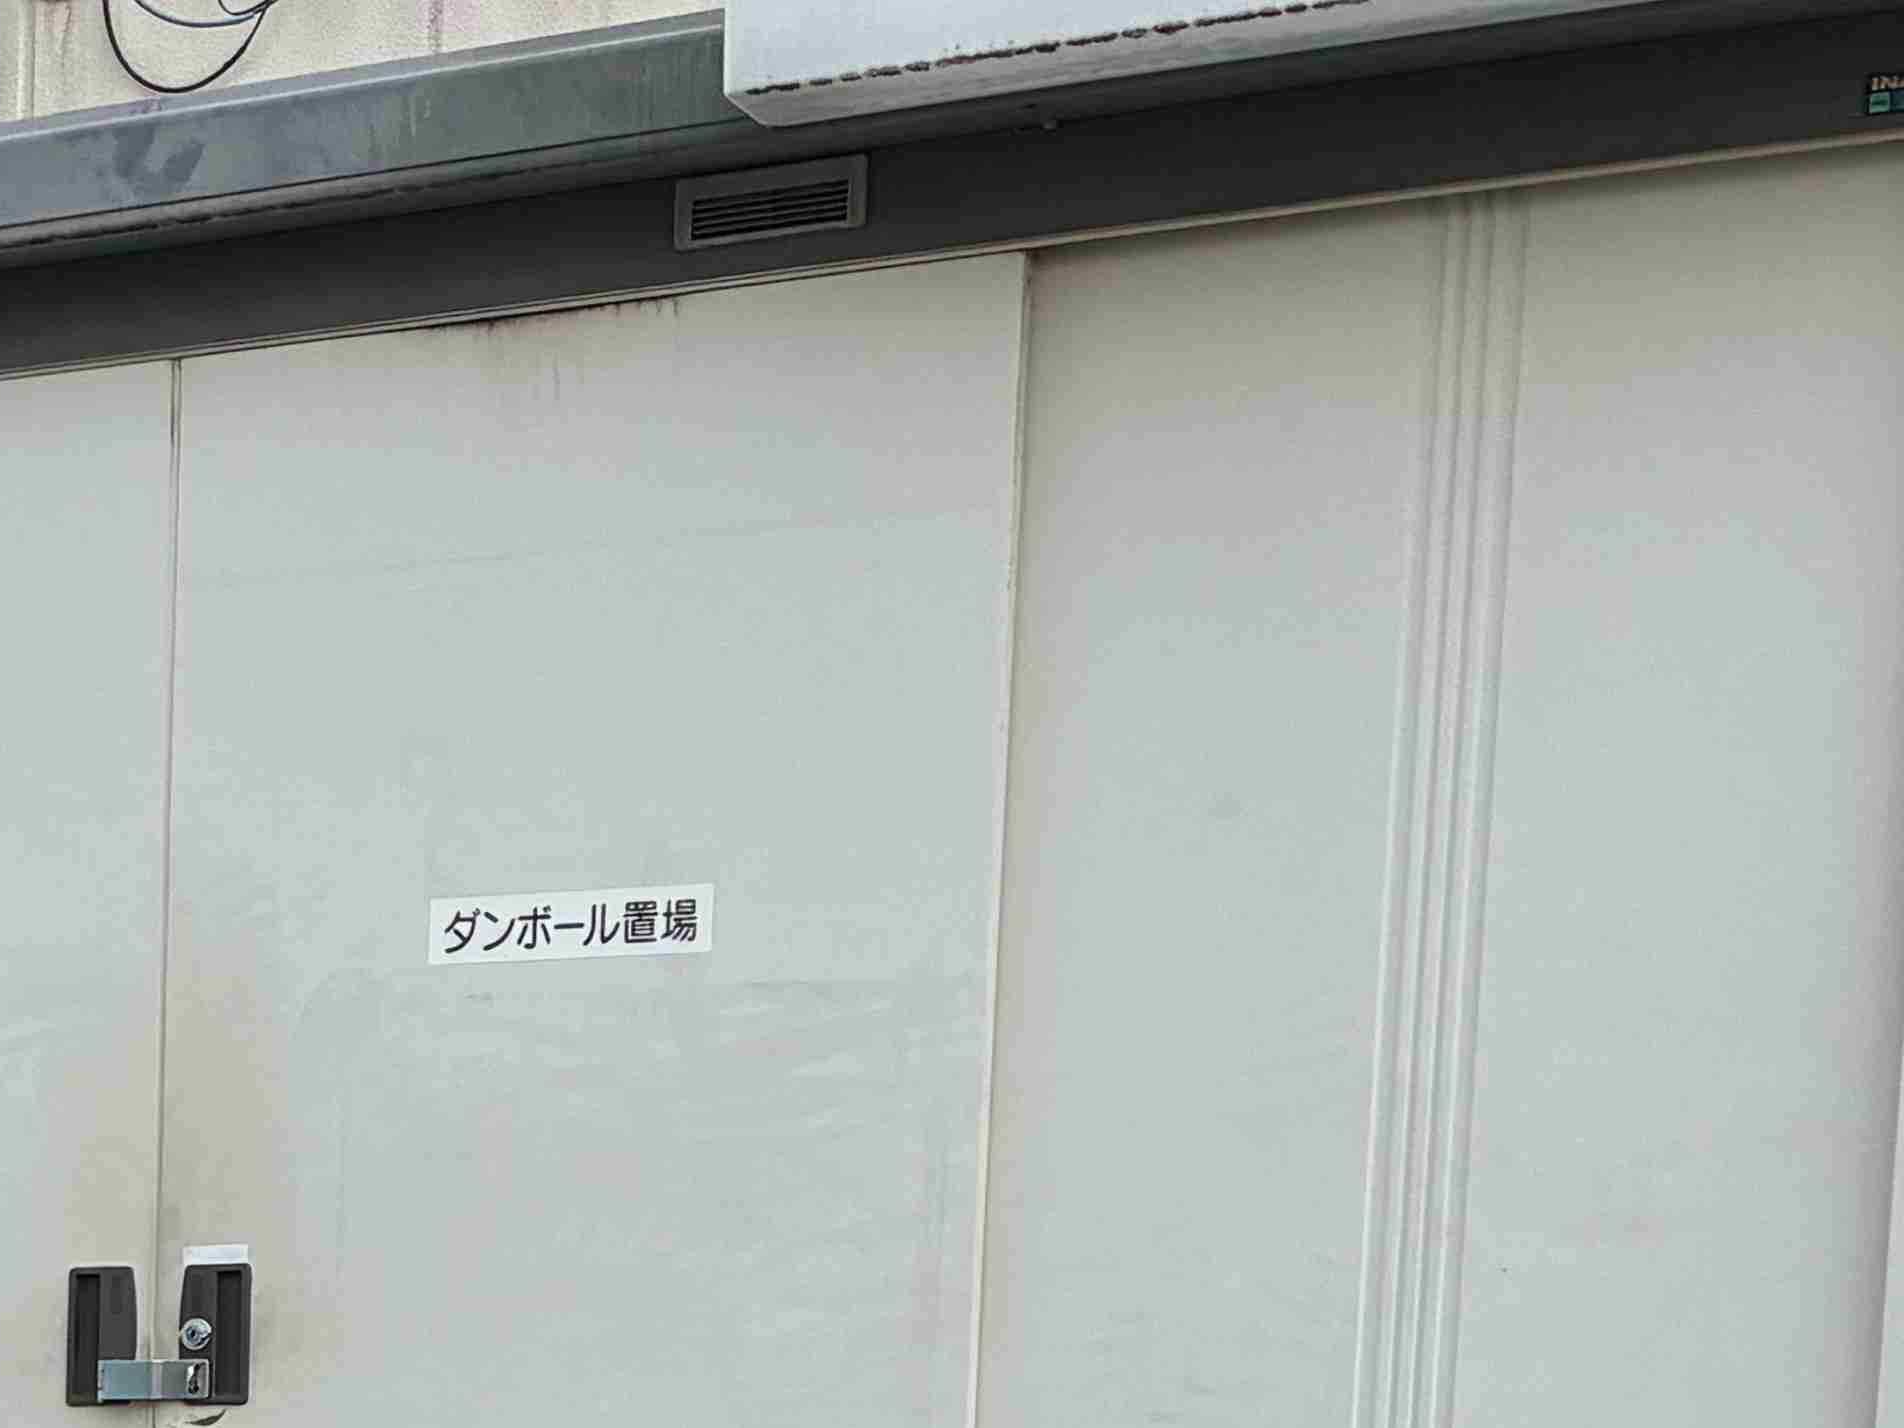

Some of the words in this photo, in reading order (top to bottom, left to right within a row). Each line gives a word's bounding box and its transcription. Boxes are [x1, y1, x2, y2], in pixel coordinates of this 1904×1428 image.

[443, 898, 700, 955] ダンボール置場
